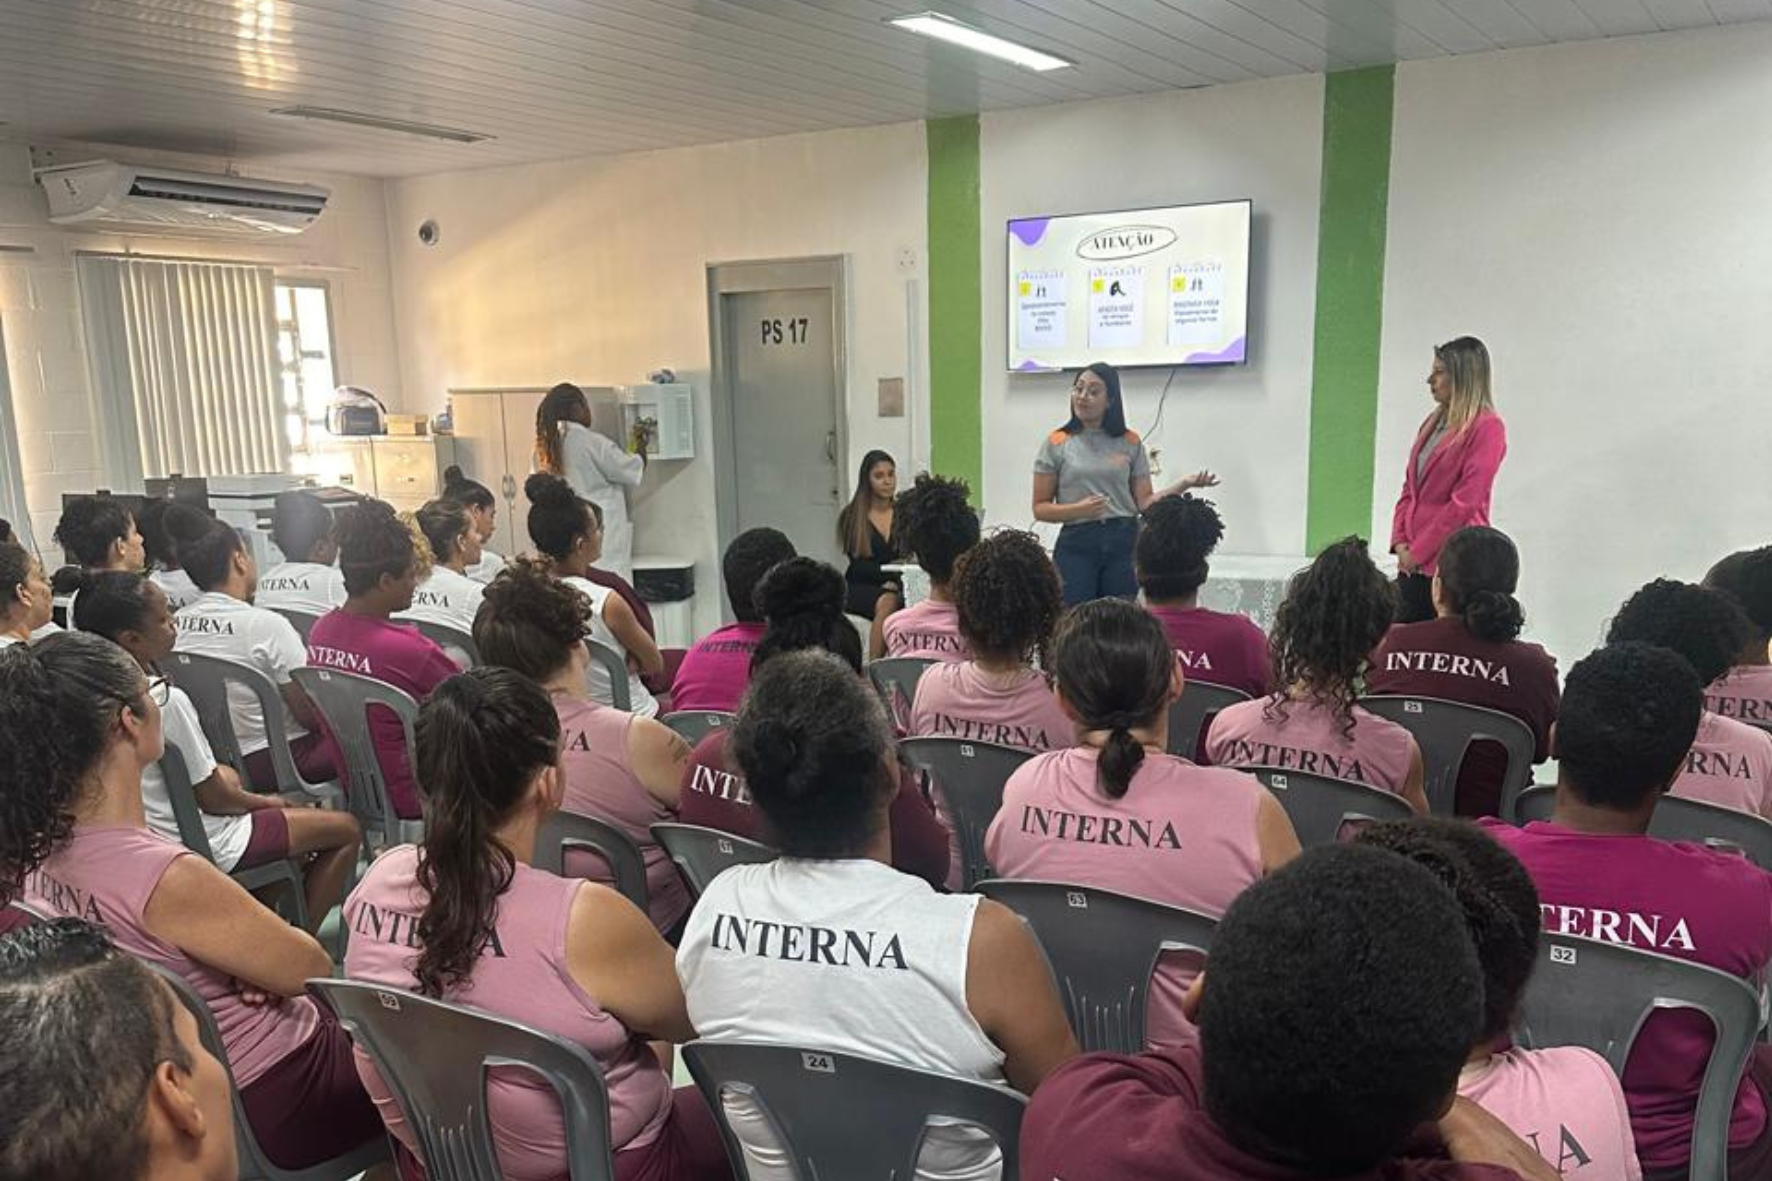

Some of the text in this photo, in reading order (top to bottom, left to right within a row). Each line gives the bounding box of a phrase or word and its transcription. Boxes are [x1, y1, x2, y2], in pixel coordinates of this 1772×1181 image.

[761, 317, 808, 345] PS 17
[261, 578, 310, 591] TERNA
[412, 589, 450, 608] ERNA
[176, 614, 234, 635] TERNA
[893, 631, 967, 654] INTERN
[307, 645, 373, 674] NTERNA
[1386, 651, 1510, 686] INTERNA
[933, 712, 1051, 750] INTERNA
[1229, 739, 1364, 781] INTERNA
[689, 764, 753, 806] INTE
[1020, 804, 1183, 851] INTERNA
[31, 868, 105, 924] TERNA
[710, 912, 910, 971] INTERNA
[1539, 903, 1697, 951] TERNA
[1553, 947, 1574, 962] 32
[808, 1055, 829, 1069] 24
